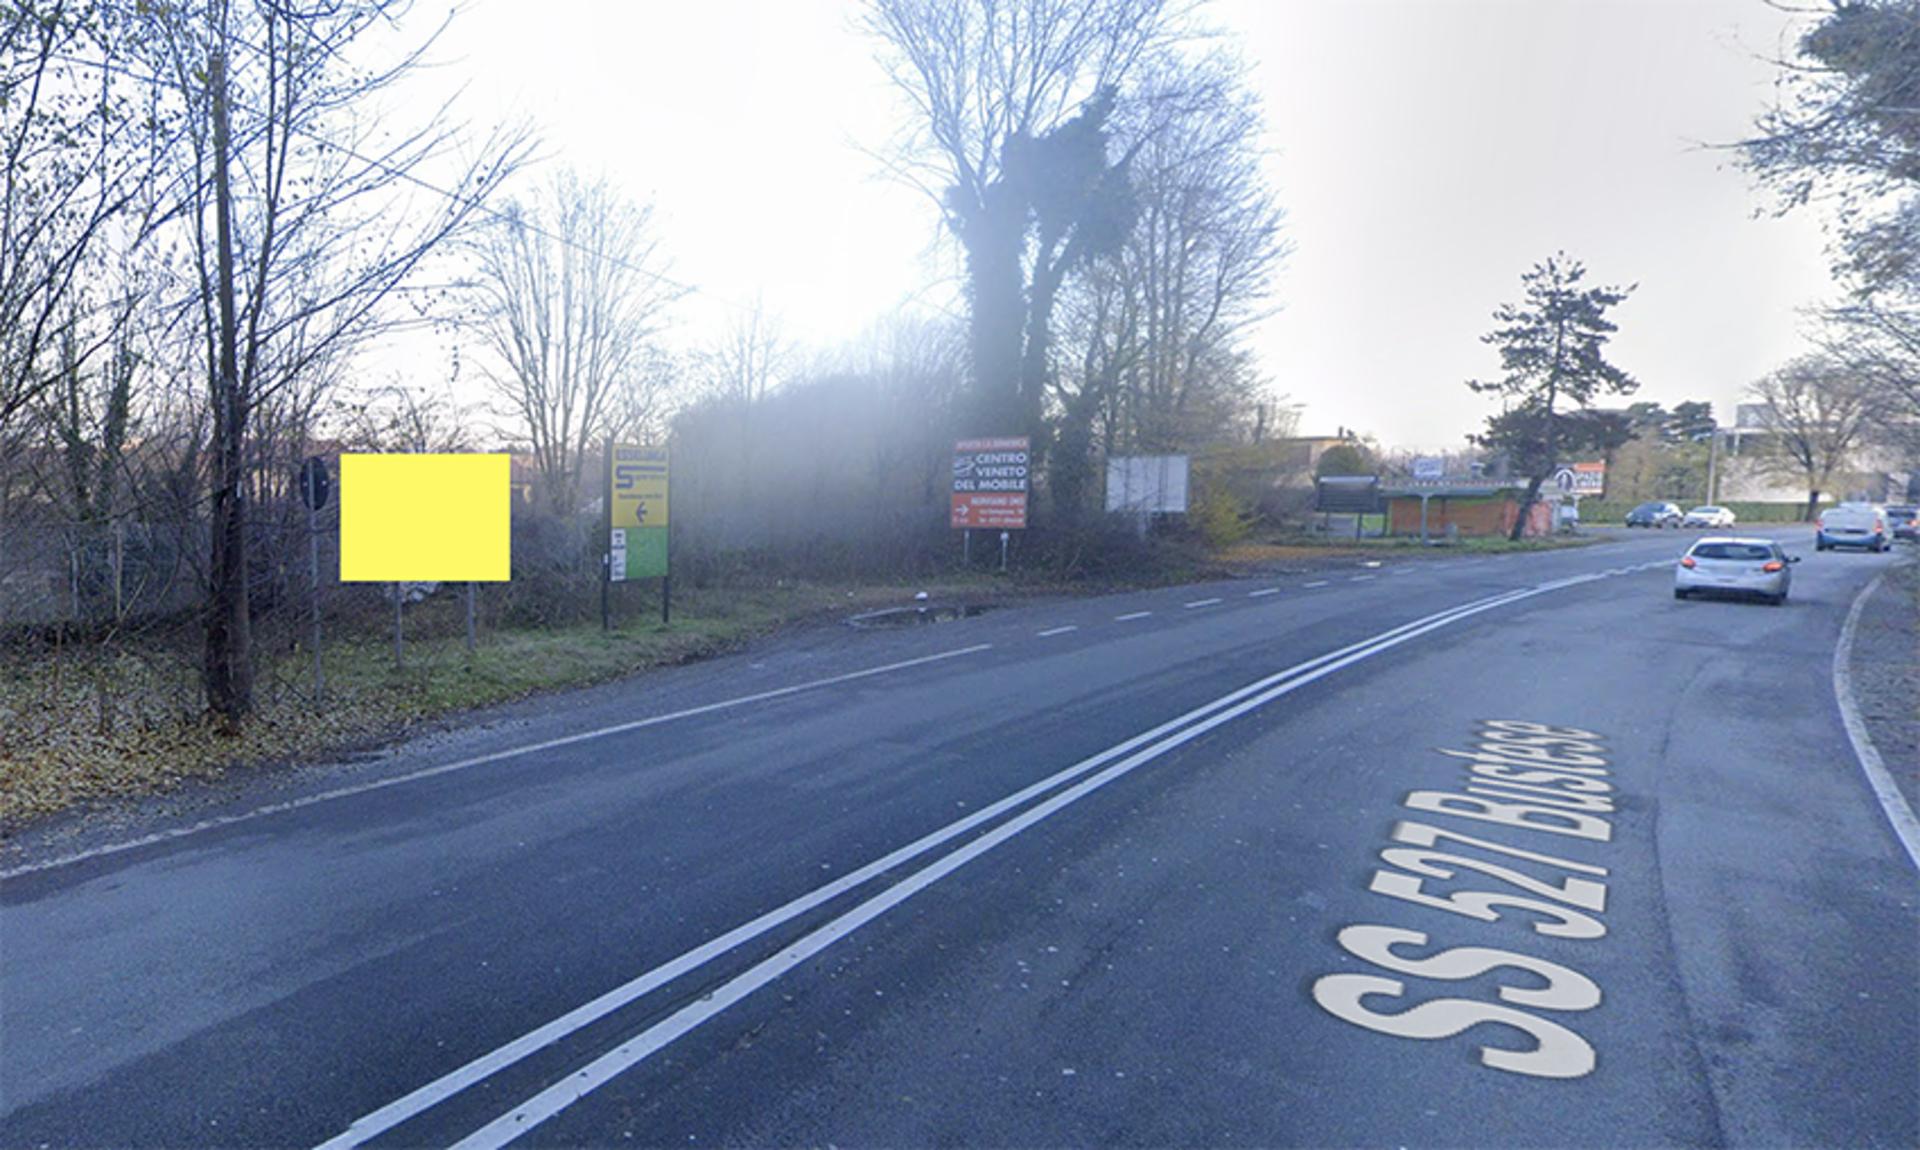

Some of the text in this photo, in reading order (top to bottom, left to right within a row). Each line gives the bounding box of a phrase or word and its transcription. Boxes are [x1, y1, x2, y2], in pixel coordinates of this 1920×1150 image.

[976, 453, 1026, 464] CENTRO
[975, 466, 1027, 477] VENETO
[954, 478, 1026, 490] DEL MOBILE
